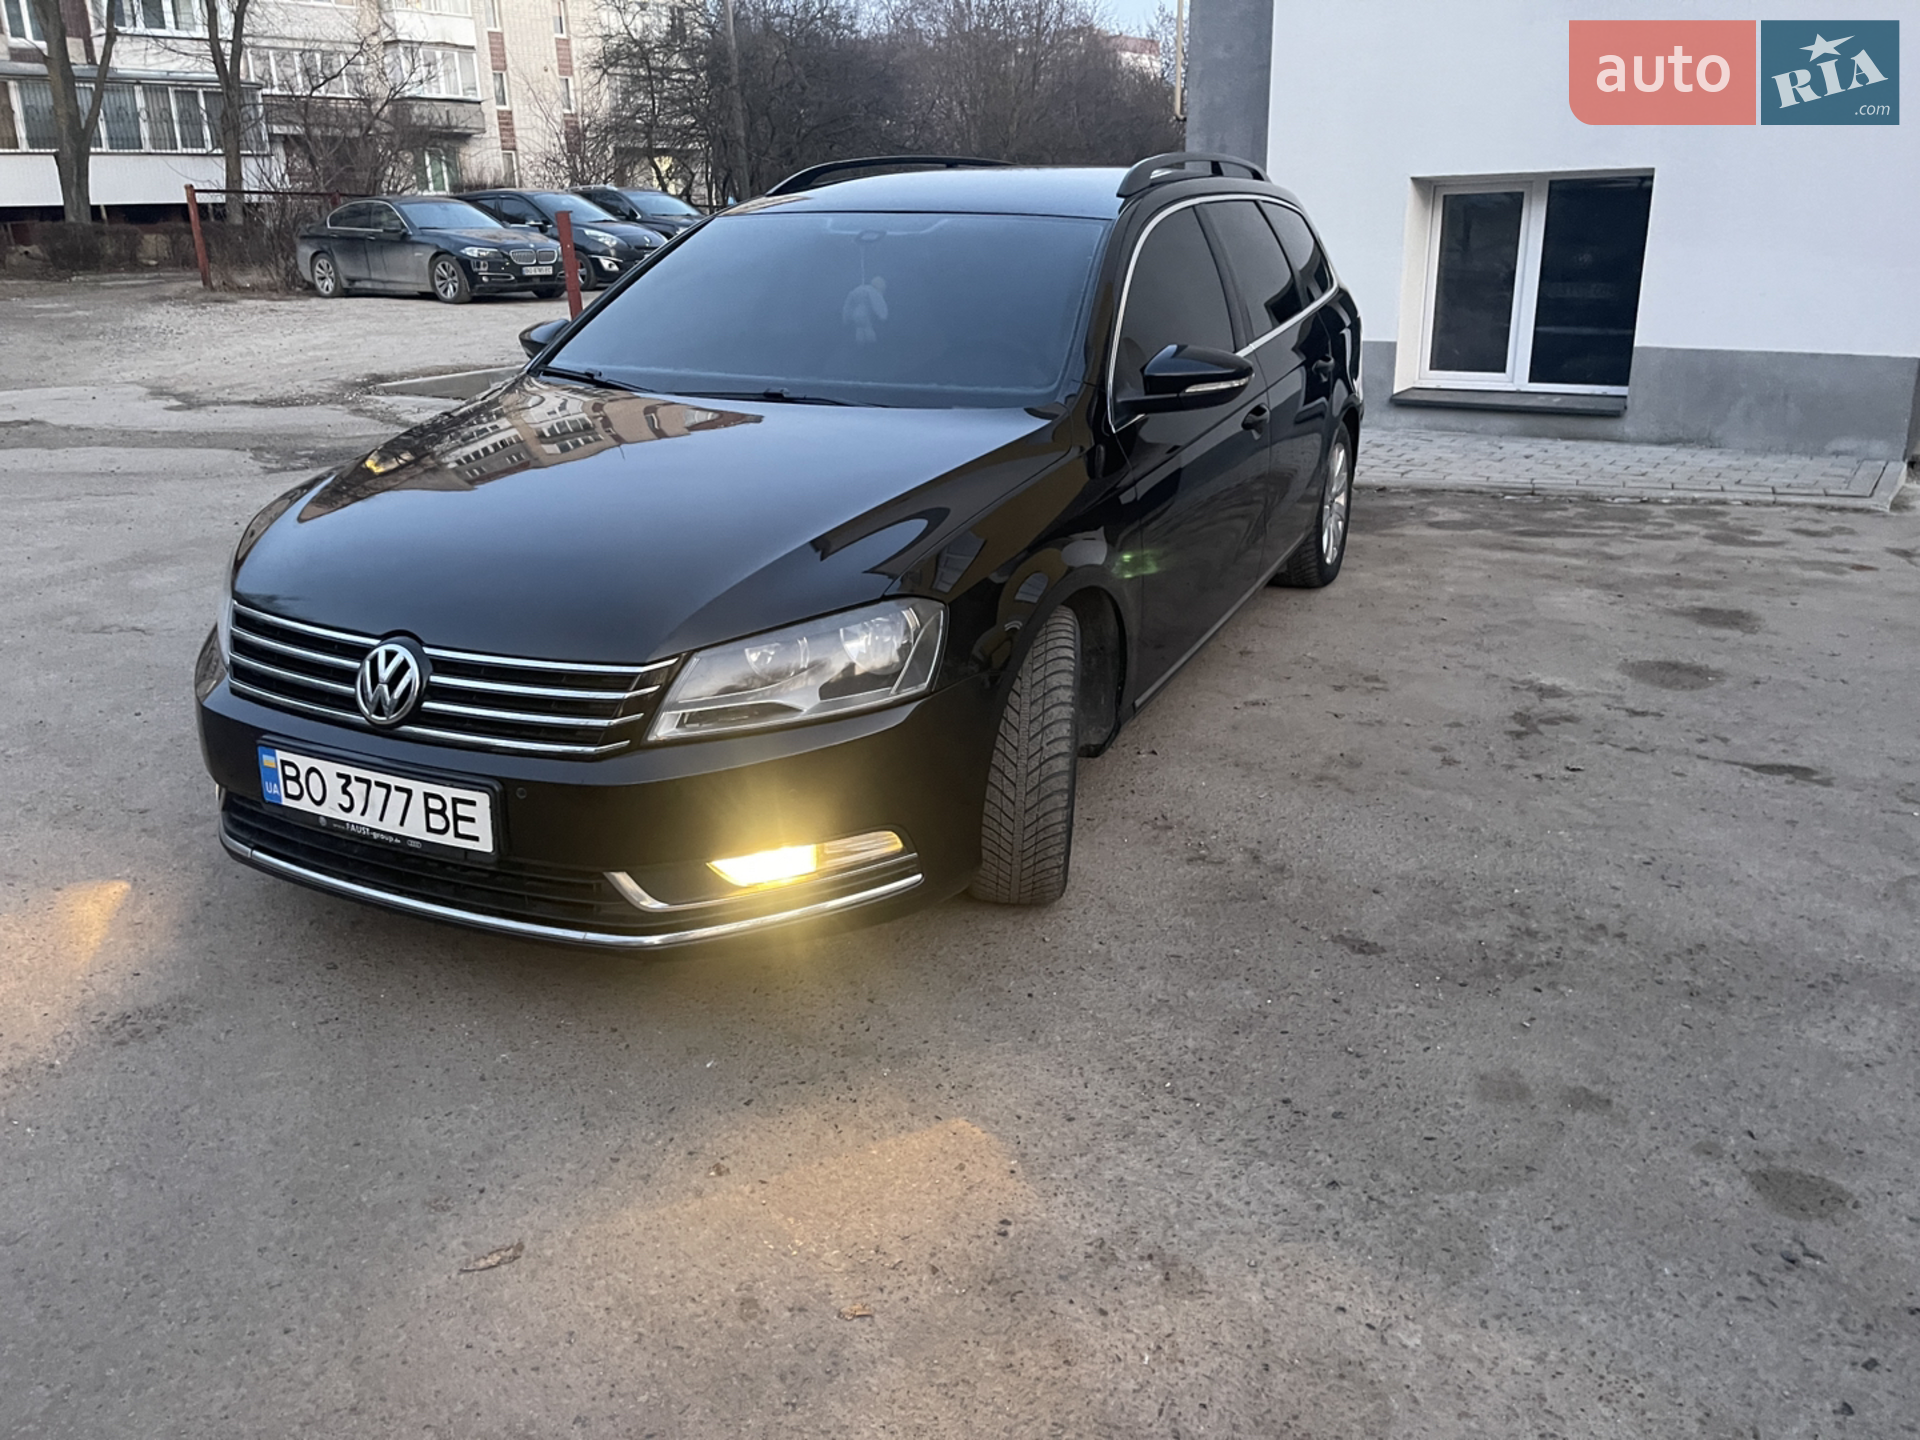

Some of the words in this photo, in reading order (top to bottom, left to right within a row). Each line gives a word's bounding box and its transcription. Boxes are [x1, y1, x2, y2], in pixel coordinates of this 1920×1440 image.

[265, 781, 280, 795] UA
[279, 759, 328, 807] BO
[335, 771, 413, 827] 3777
[422, 791, 480, 842] BE
